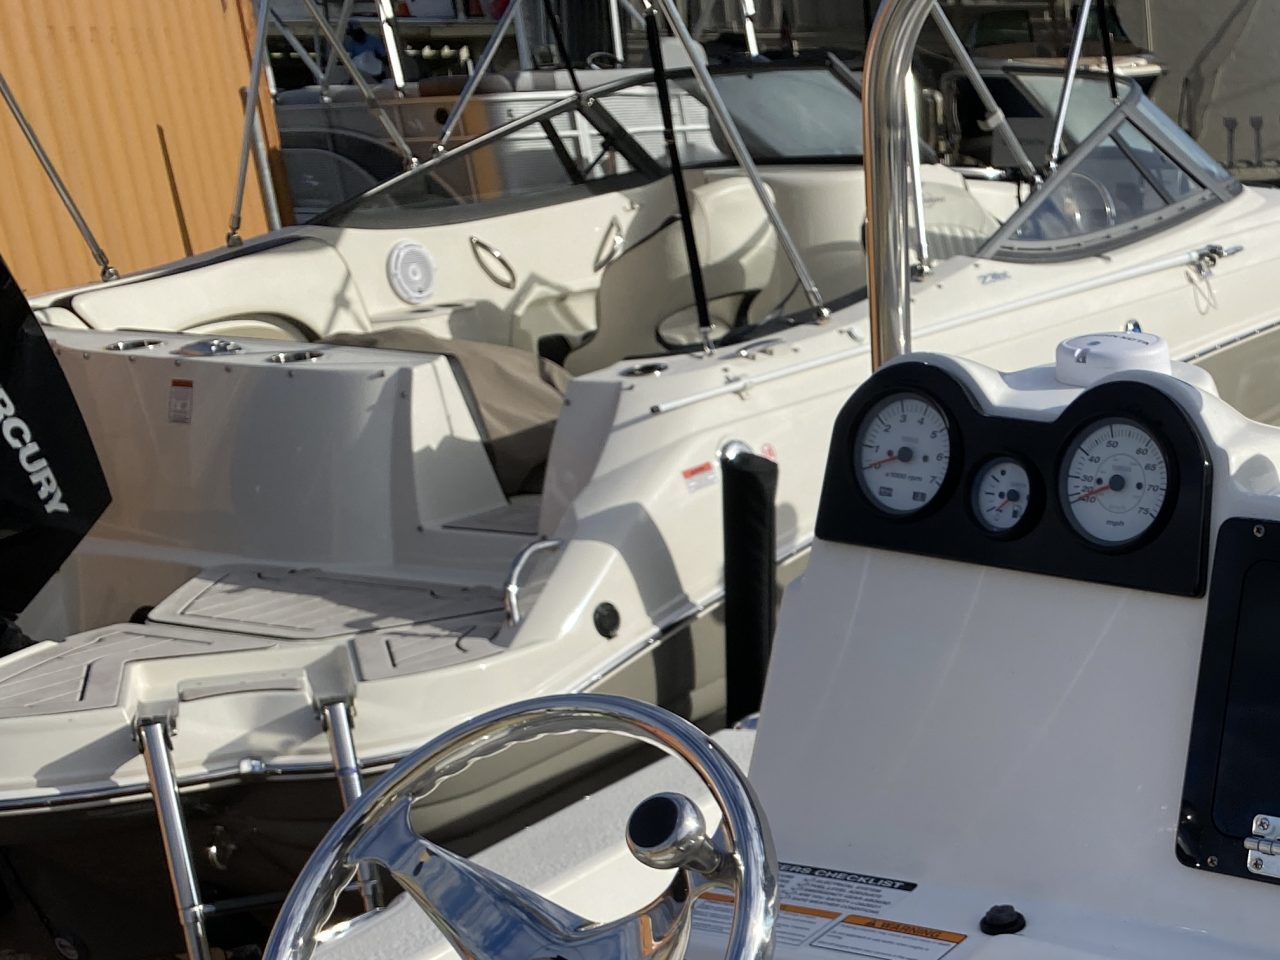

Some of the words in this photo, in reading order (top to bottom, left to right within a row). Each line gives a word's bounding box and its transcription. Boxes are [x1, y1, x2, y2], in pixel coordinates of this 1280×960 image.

[900, 414, 908, 424] 3
[917, 417, 925, 425] 4
[883, 424, 892, 433] 2
[930, 430, 938, 439] 5
[1105, 441, 1119, 449] 50
[1136, 448, 1148, 456] 60
[936, 453, 943, 462] 6
[929, 475, 938, 484] 7
[1147, 484, 1160, 492] 70
[1138, 507, 1150, 515] 75
[814, 868, 905, 889] CHECKLIST
